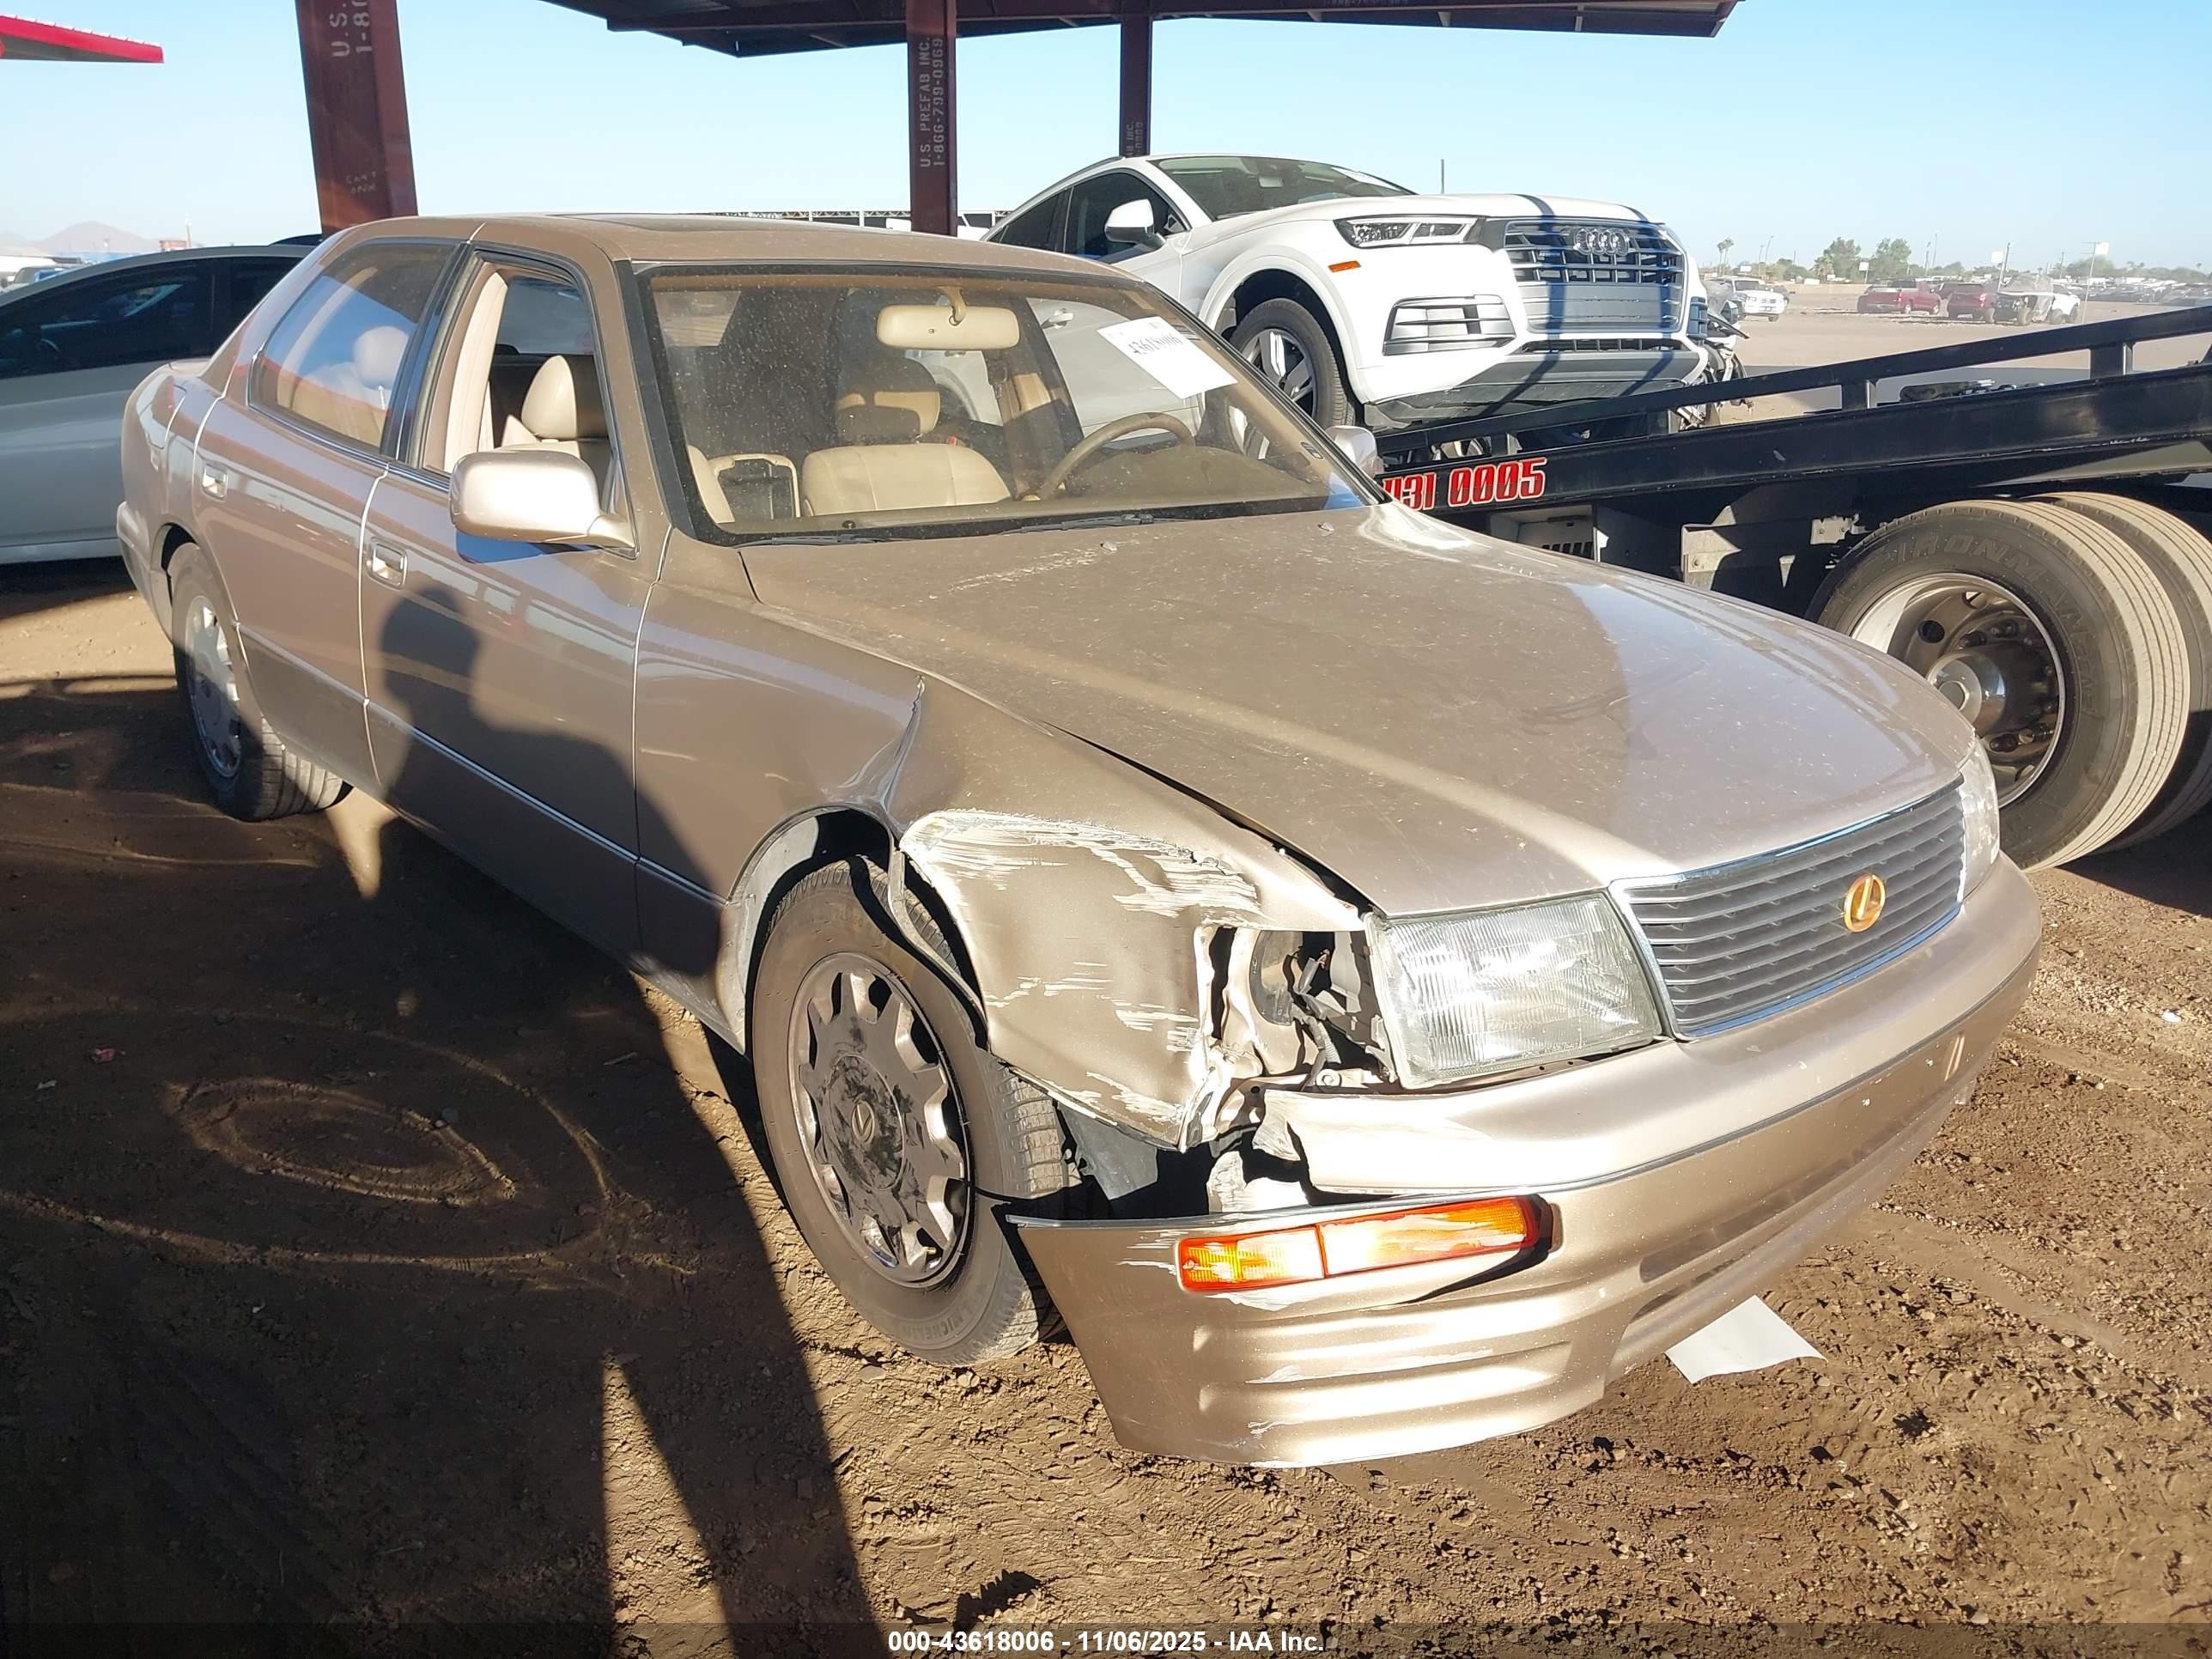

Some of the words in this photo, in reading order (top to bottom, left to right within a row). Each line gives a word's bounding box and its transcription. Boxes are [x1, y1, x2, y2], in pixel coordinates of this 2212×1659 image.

[329, 3, 350, 58] U.S.
[918, 37, 930, 65] INC.
[919, 73, 931, 131] PREFAB
[932, 38, 945, 166] 1-866-799-0969
[1448, 457, 1547, 507] 0005
